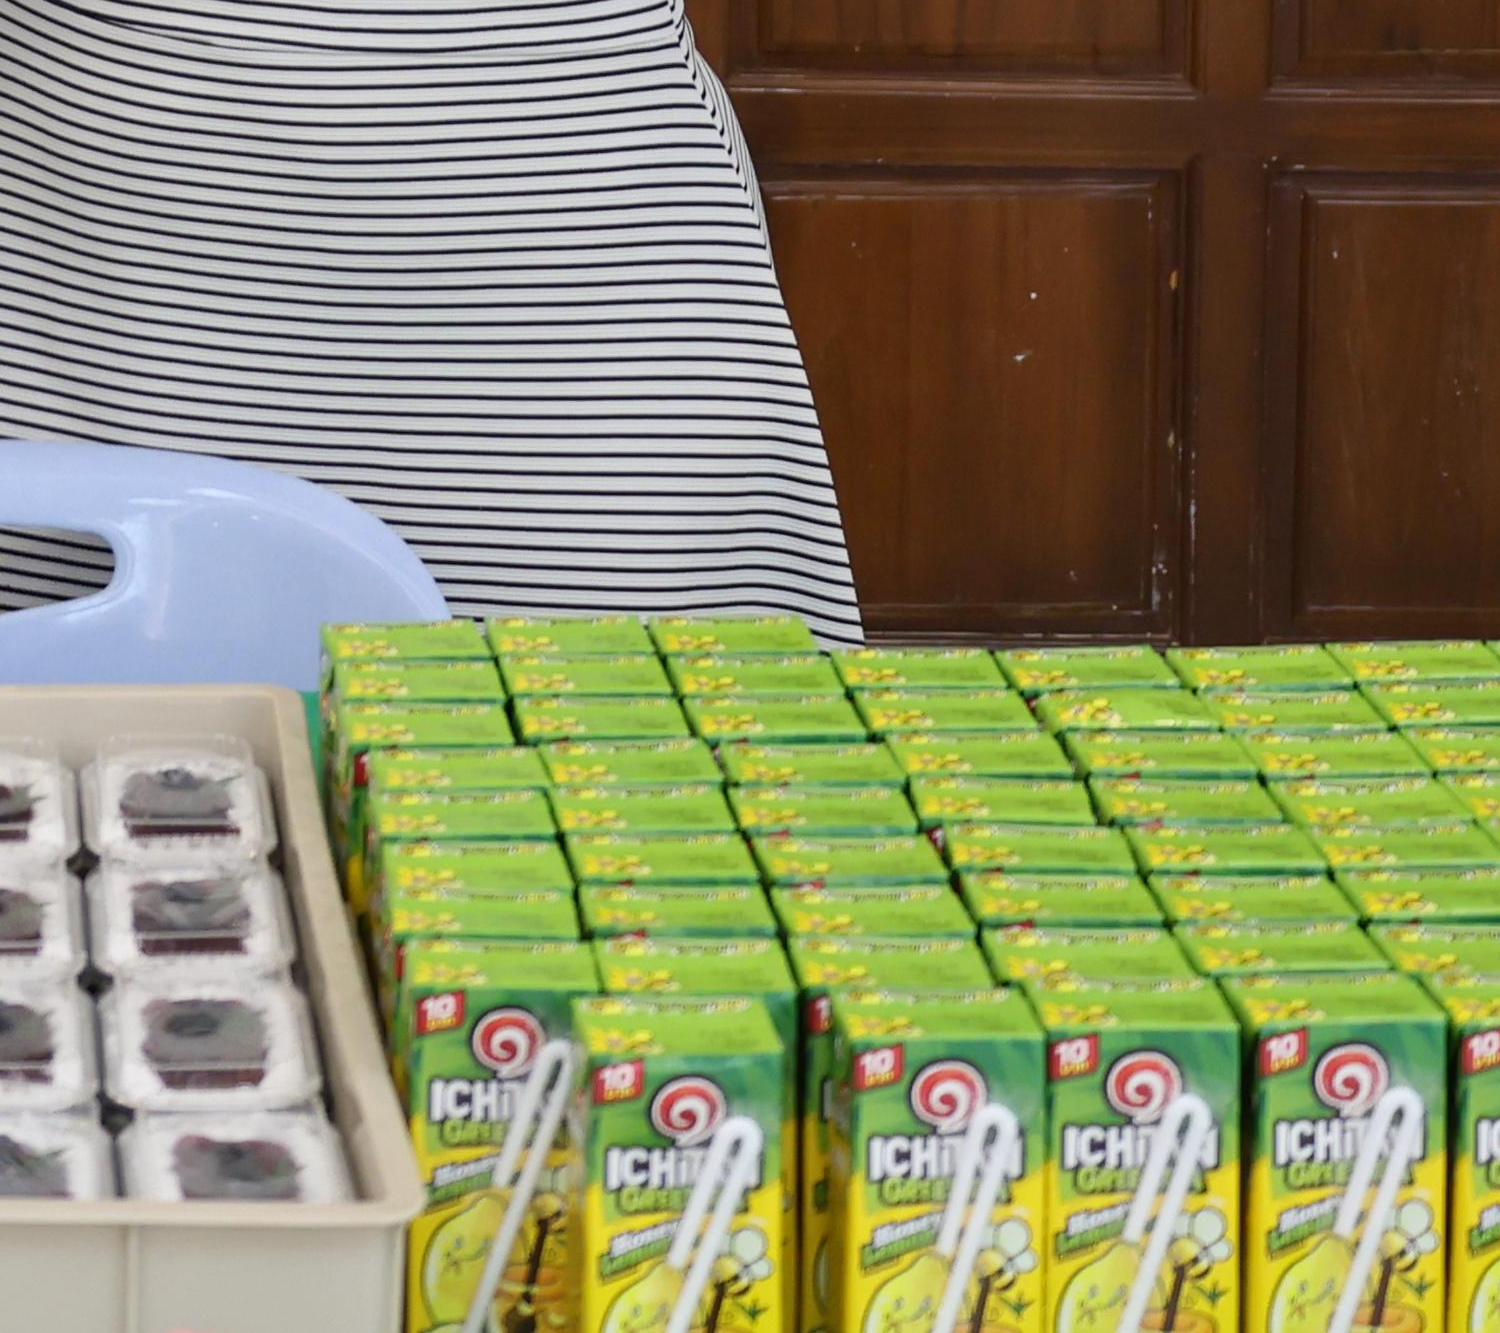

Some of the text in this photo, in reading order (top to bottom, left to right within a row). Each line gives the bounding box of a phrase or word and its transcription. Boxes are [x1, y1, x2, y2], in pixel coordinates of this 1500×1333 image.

[421, 992, 457, 1017] 10
[1055, 1038, 1090, 1064] 10
[1266, 1033, 1300, 1060] 10
[1468, 1030, 1500, 1058] 10
[860, 1048, 896, 1075] 10
[600, 1063, 636, 1090] 10
